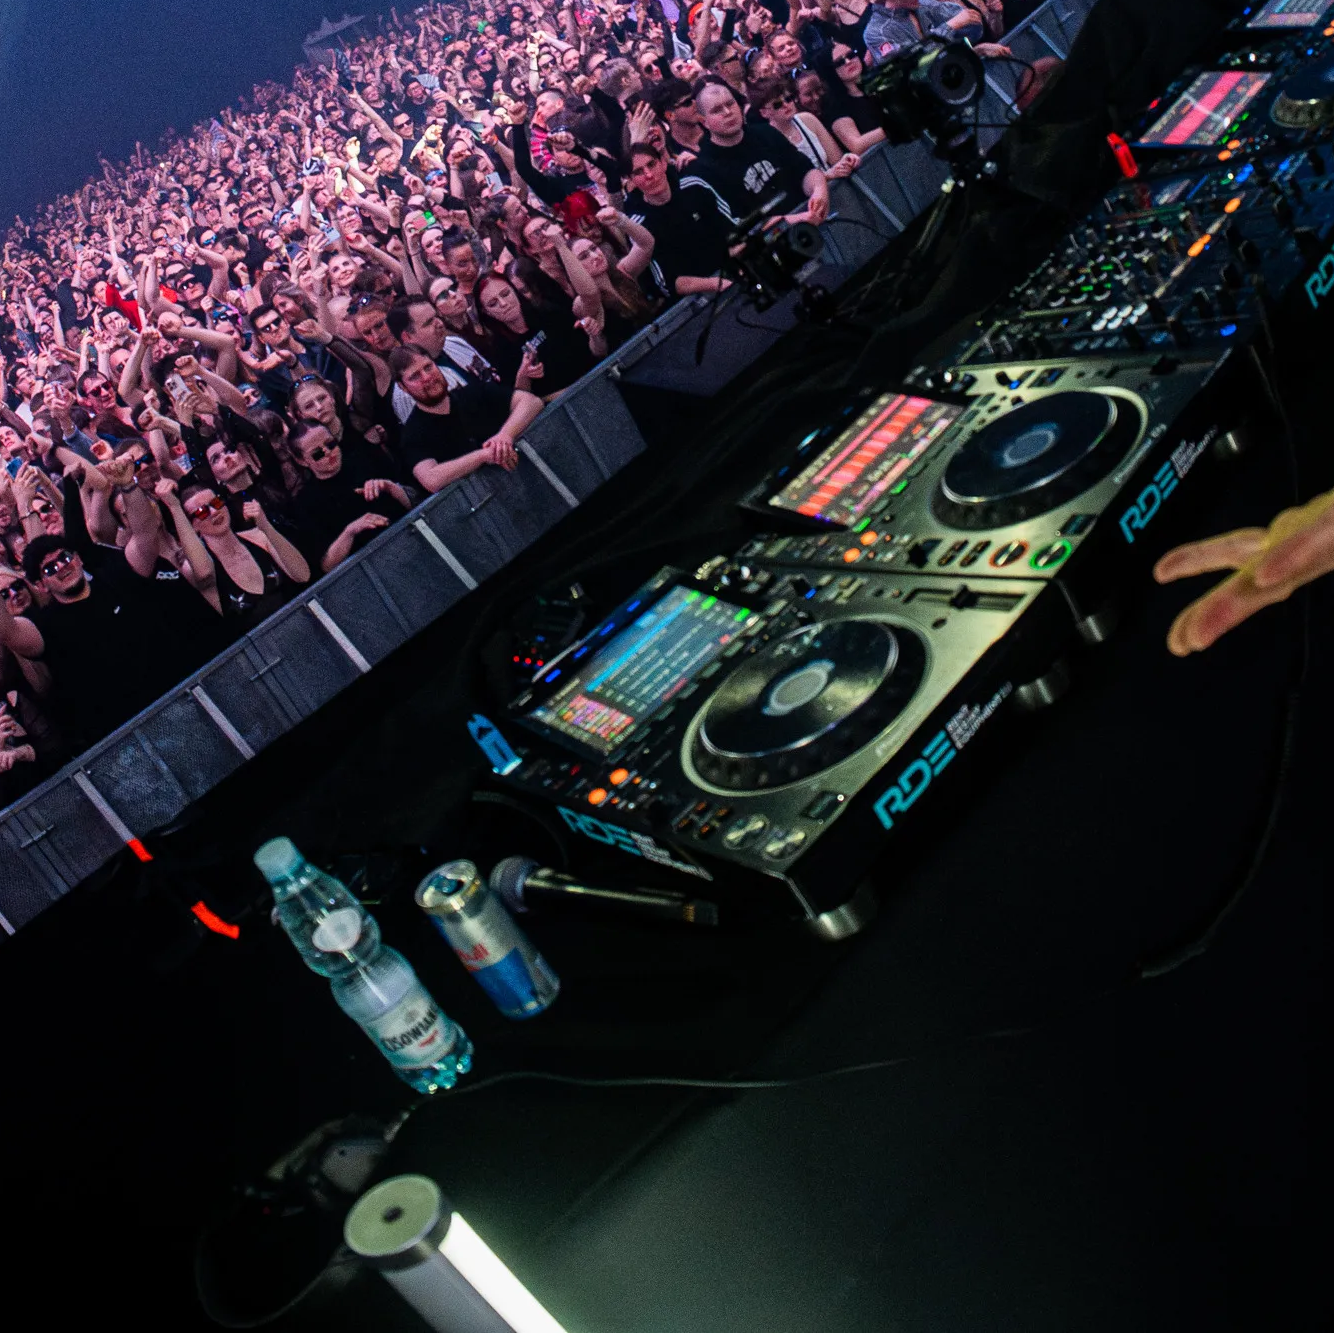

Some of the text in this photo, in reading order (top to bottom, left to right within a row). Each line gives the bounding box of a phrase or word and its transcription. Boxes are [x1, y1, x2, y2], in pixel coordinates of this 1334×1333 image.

[1119, 460, 1179, 543] RDE
[873, 729, 957, 830] RDE
[555, 805, 643, 857] RDE
